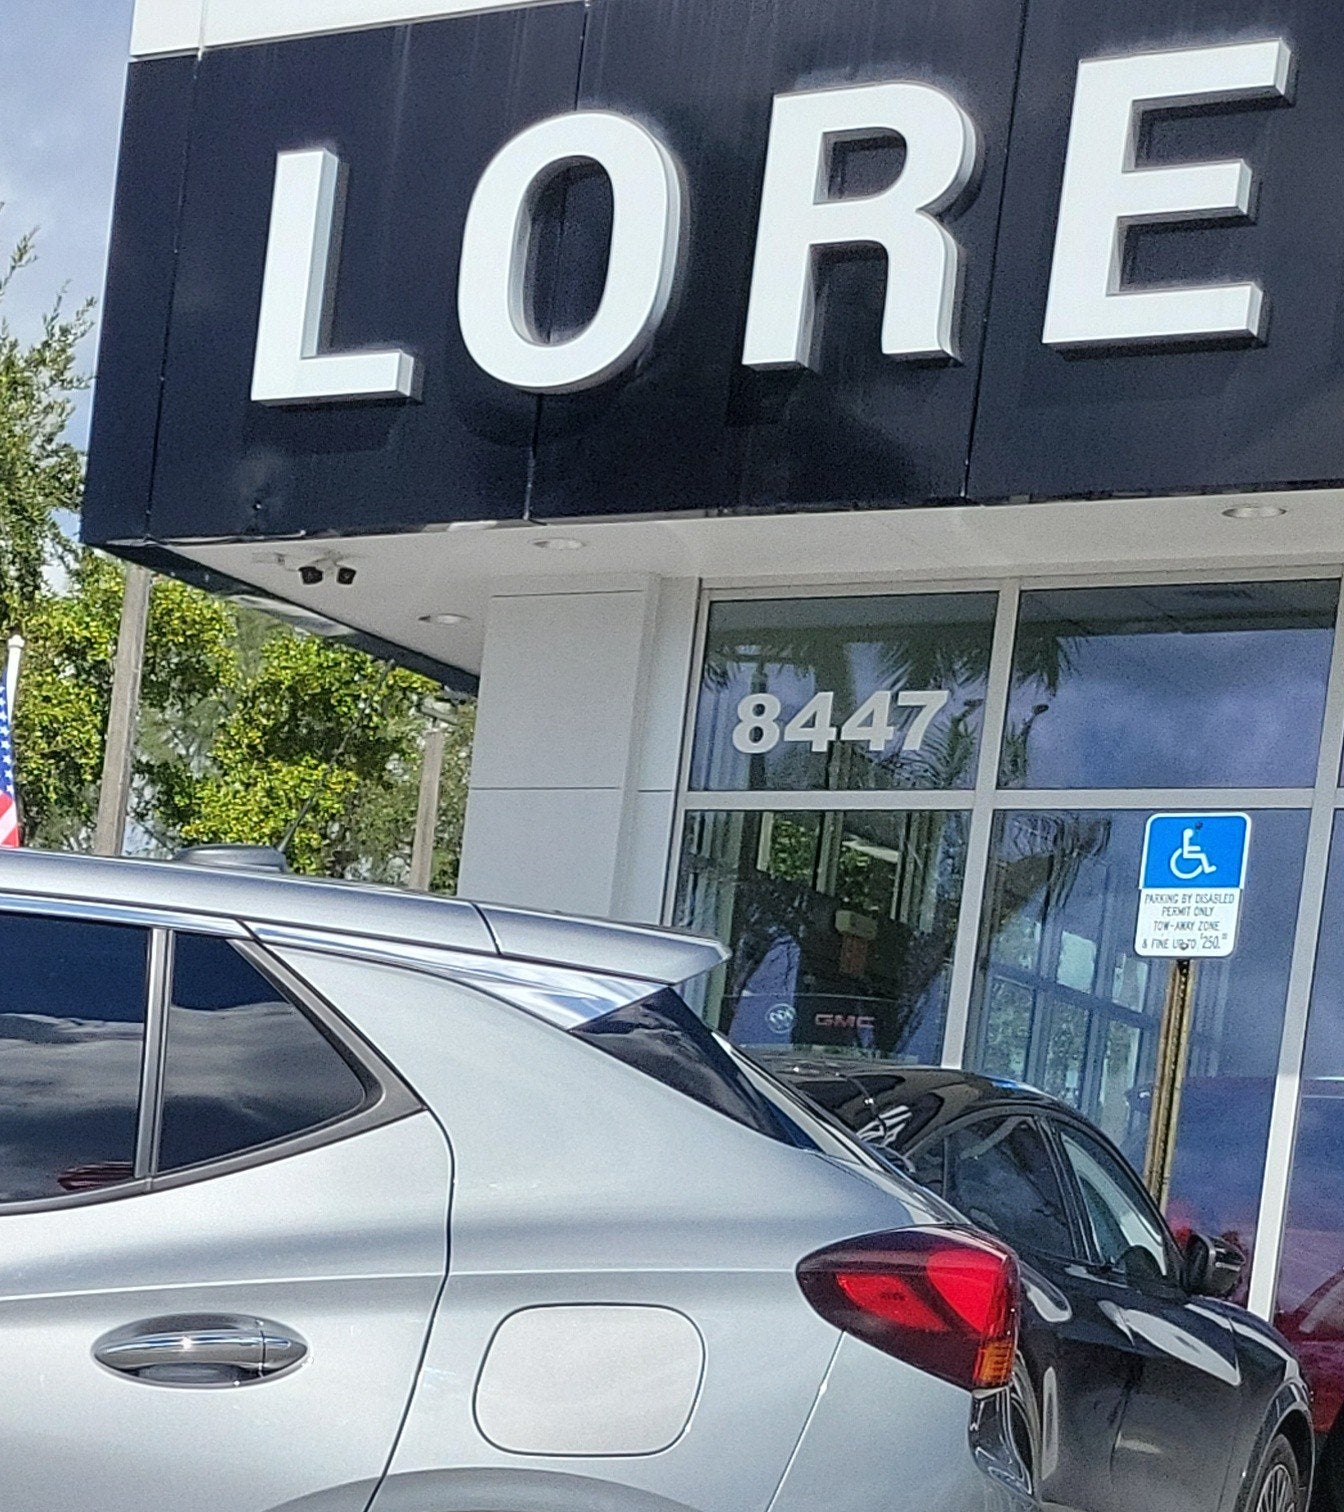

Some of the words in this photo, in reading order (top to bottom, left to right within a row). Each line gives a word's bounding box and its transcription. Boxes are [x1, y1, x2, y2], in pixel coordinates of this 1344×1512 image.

[250, 37, 1293, 406] LORE
[731, 690, 950, 754] 8447
[1144, 893, 1179, 904] PARKING
[1181, 893, 1192, 904] BY
[1195, 893, 1235, 904] DISABLED
[1161, 906, 1191, 917] PERMIT
[1193, 906, 1214, 917] ONLY
[1154, 920, 1195, 931] TOW-AWAY
[1197, 920, 1220, 931] ZONE
[1151, 938, 1169, 949] FINE
[815, 1013, 875, 1029] GMC
